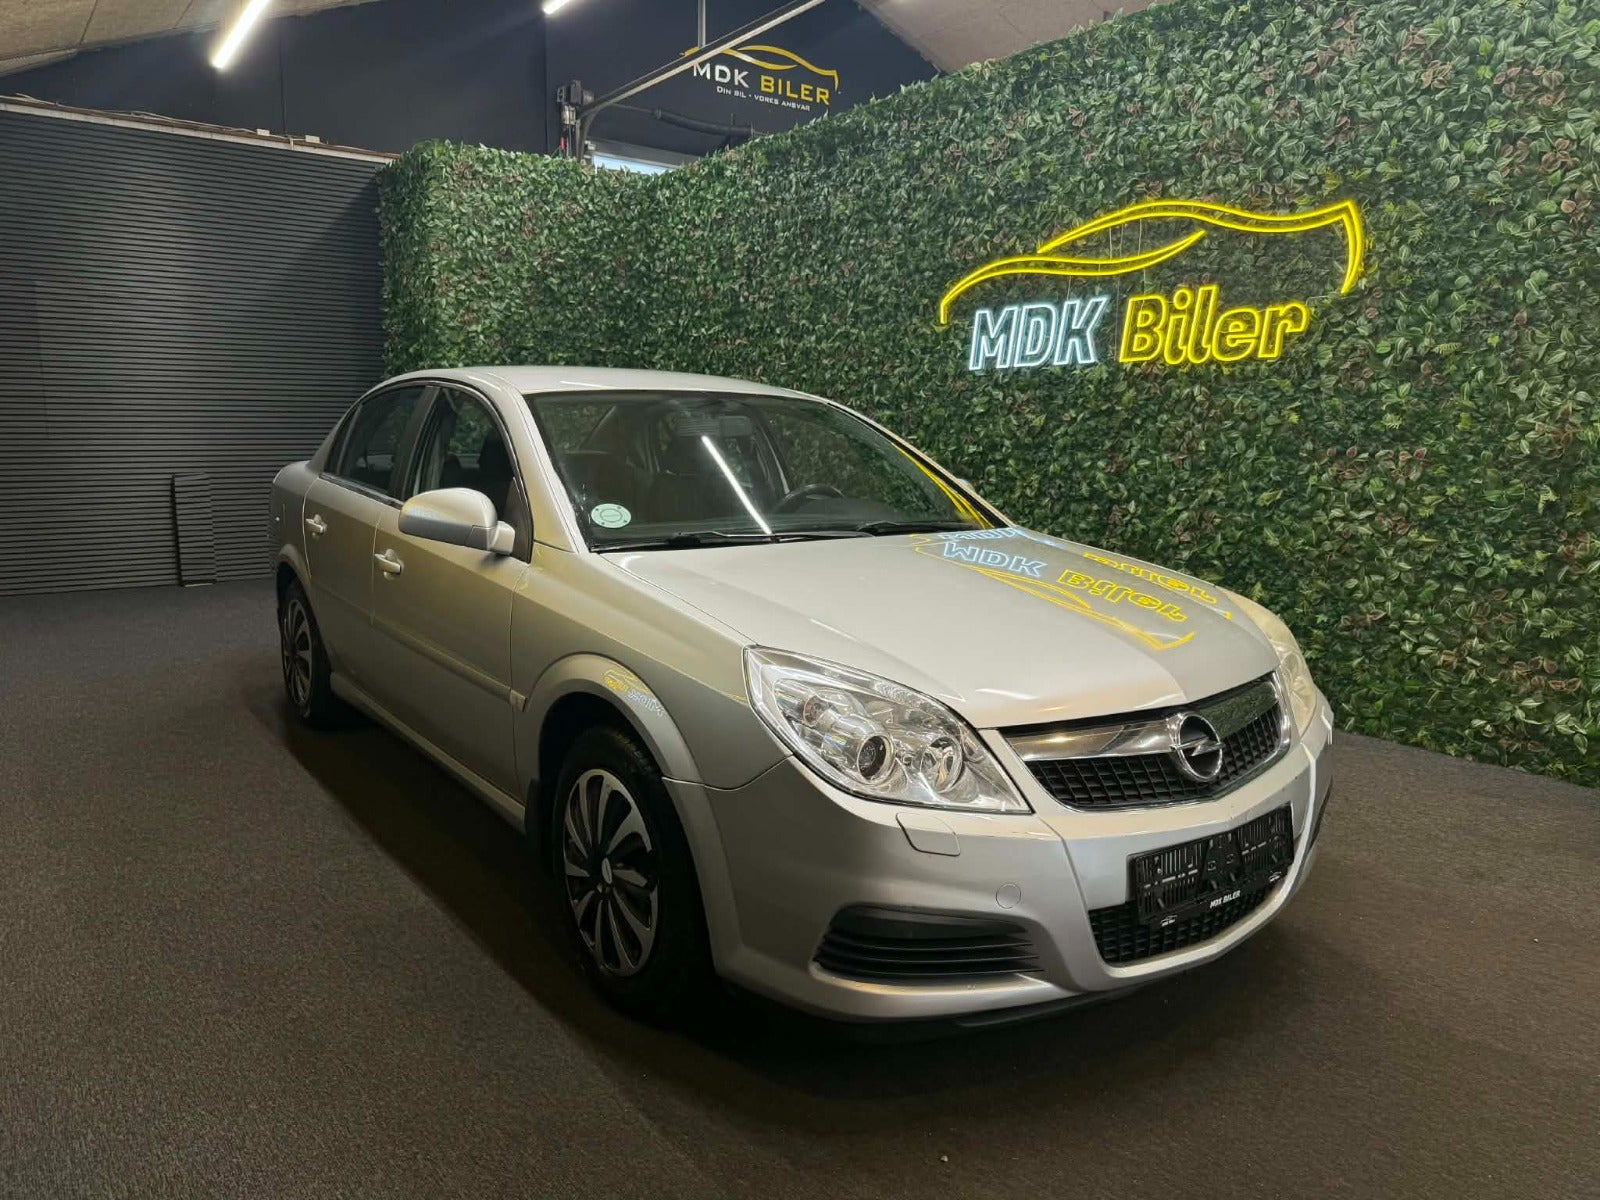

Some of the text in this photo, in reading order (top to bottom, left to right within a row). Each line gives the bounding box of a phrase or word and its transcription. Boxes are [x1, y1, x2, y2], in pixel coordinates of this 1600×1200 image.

[693, 62, 830, 106] MDK BILER
[968, 284, 1309, 371] MDK Biler
